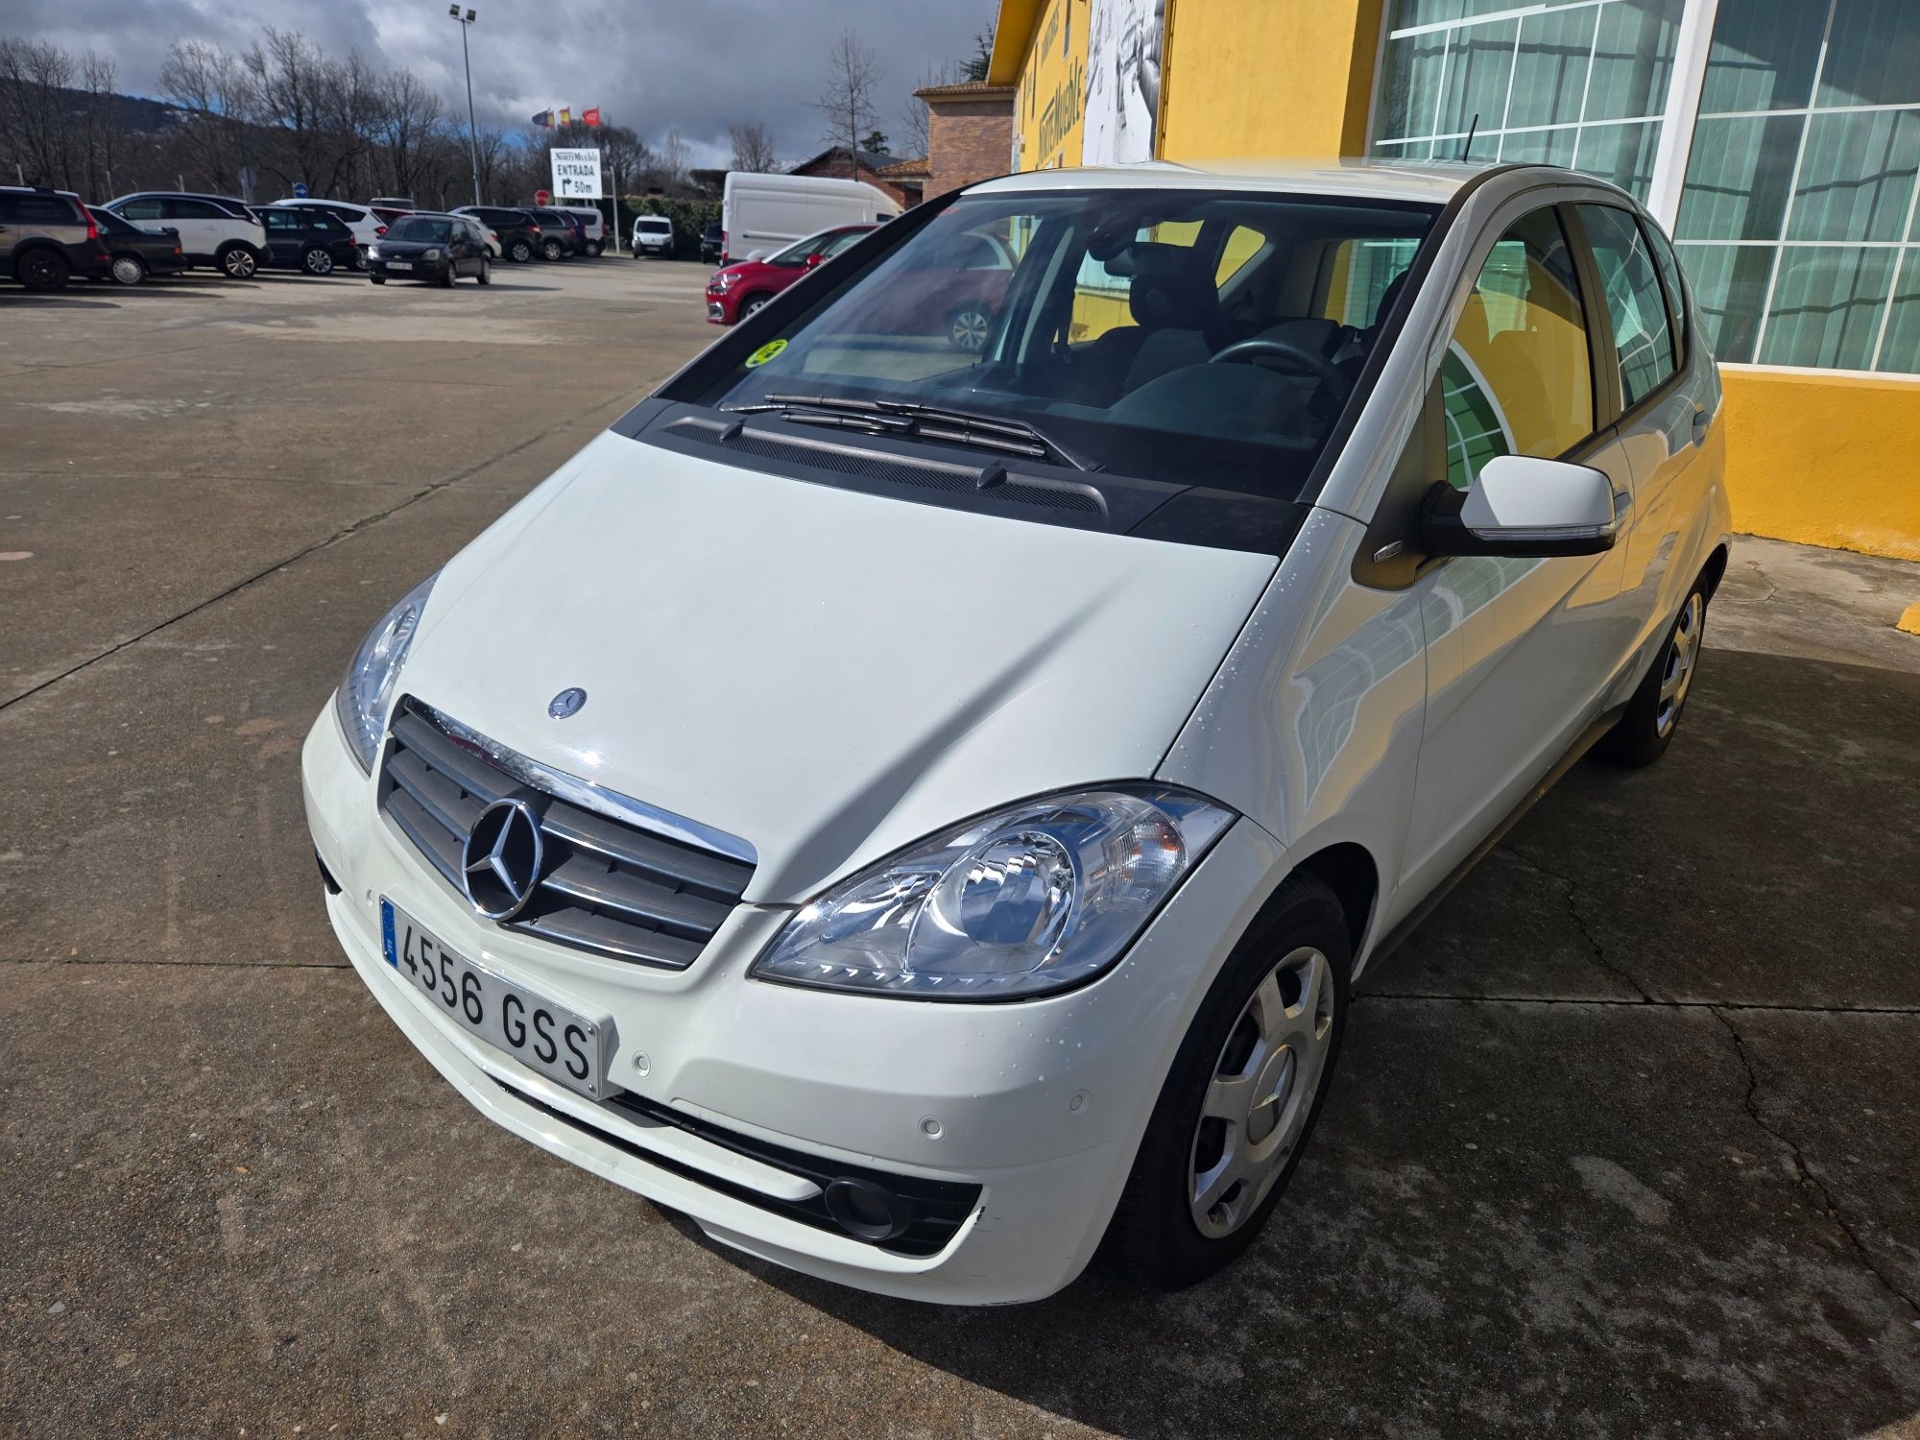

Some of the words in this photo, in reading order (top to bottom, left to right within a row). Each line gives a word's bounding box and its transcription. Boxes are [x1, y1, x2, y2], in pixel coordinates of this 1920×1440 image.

[557, 164, 595, 176] ENTRADA
[574, 181, 593, 194] 50m
[387, 938, 394, 955] E
[403, 925, 484, 1026] 4556
[502, 993, 590, 1081] GSS
